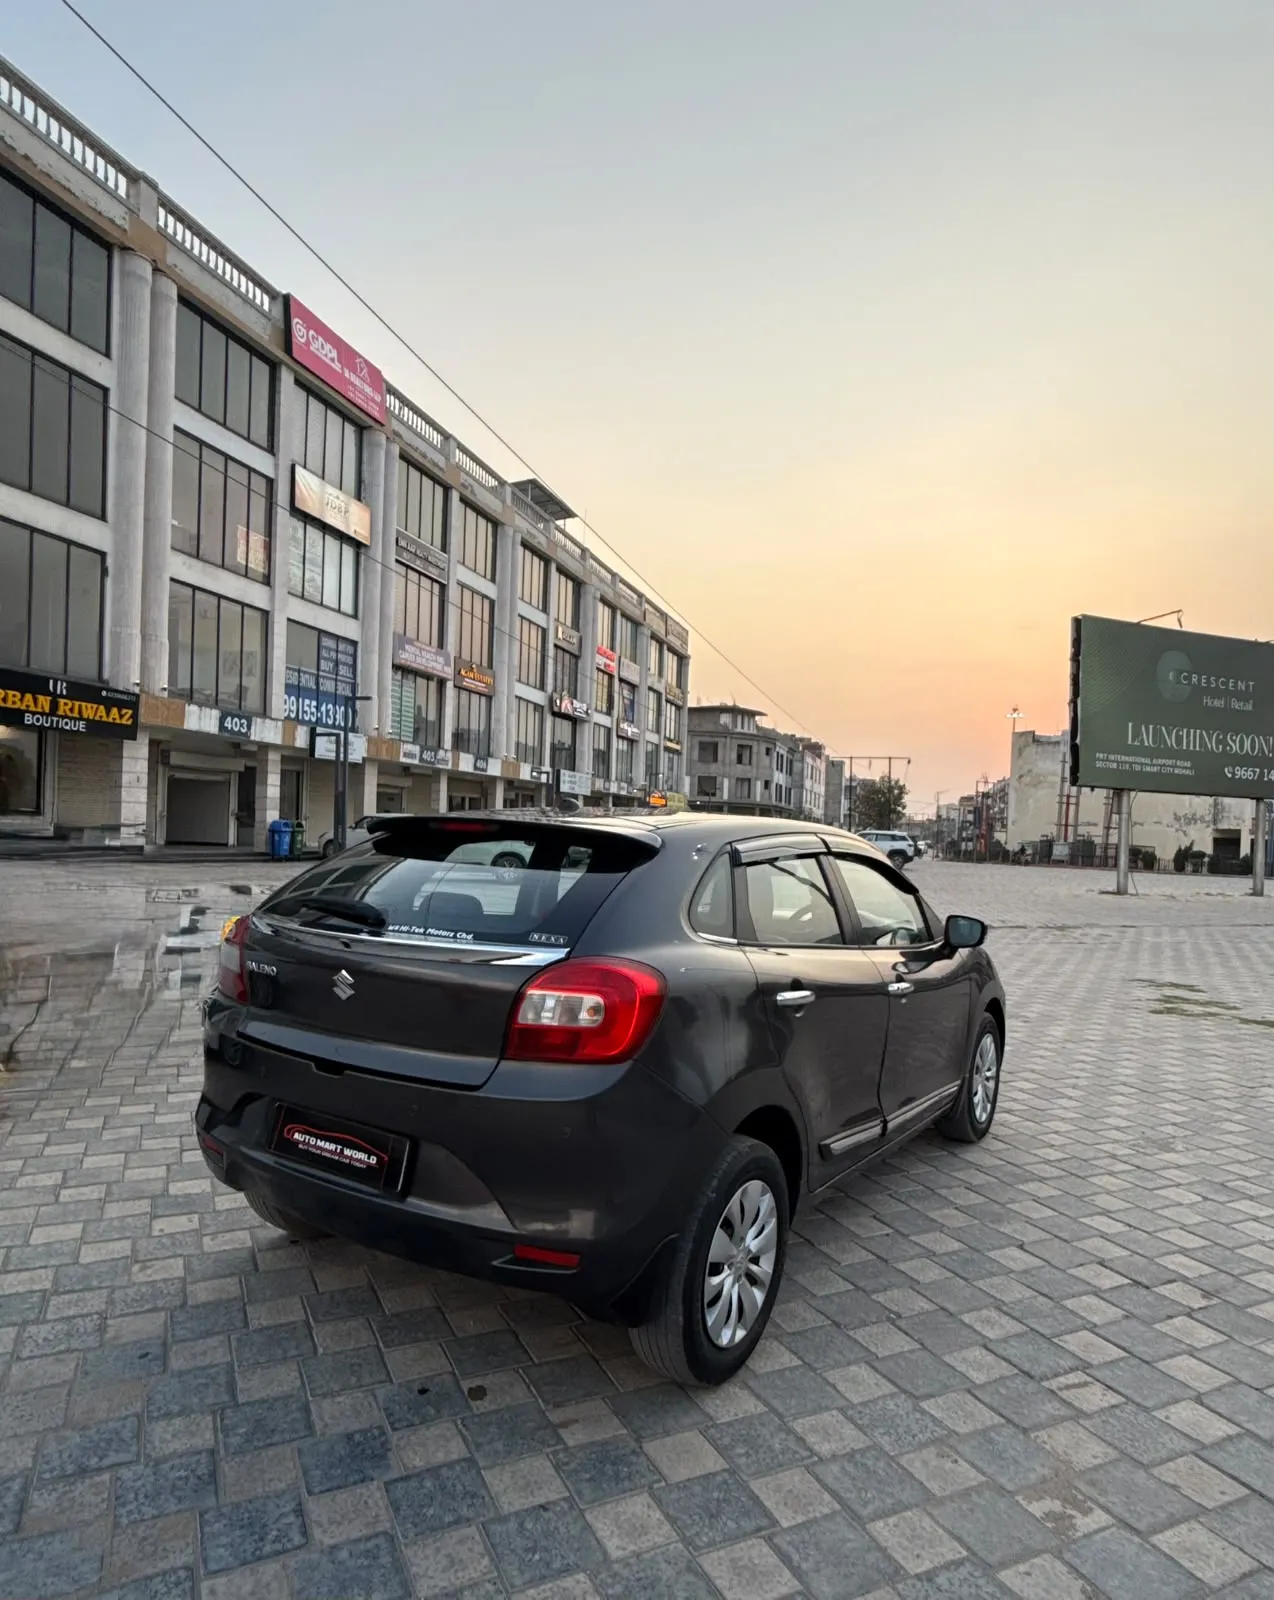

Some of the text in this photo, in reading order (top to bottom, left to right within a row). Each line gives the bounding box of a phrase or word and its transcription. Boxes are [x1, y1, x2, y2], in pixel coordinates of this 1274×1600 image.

[309, 329, 342, 367] GDPL
[321, 660, 354, 678] BUY SELL
[286, 669, 317, 689] ESIDENTIAL
[1181, 672, 1256, 692] CRESCENT
[56, 698, 133, 725] RIWAAZ
[1203, 696, 1253, 711] Hotel Retail
[24, 713, 87, 732] BOUTIQUE
[224, 716, 248, 733] 403
[1127, 722, 1273, 757] LAUNCHING SOON!
[1096, 761, 1117, 769] SECTOR
[1142, 765, 1160, 773] SMART
[1161, 766, 1173, 774] CITY
[1108, 753, 1151, 764] INTERNATIONAL
[1152, 758, 1176, 766] AIRPORT
[1234, 766, 1260, 780] 9667
[399, 925, 425, 934] Hi-Tek
[426, 928, 455, 938] Motors
[533, 932, 564, 945] NEXA
[293, 1132, 377, 1164] AUTO MART WORLD
[321, 1151, 339, 1160] DREAM
[339, 1155, 350, 1163] CAR
